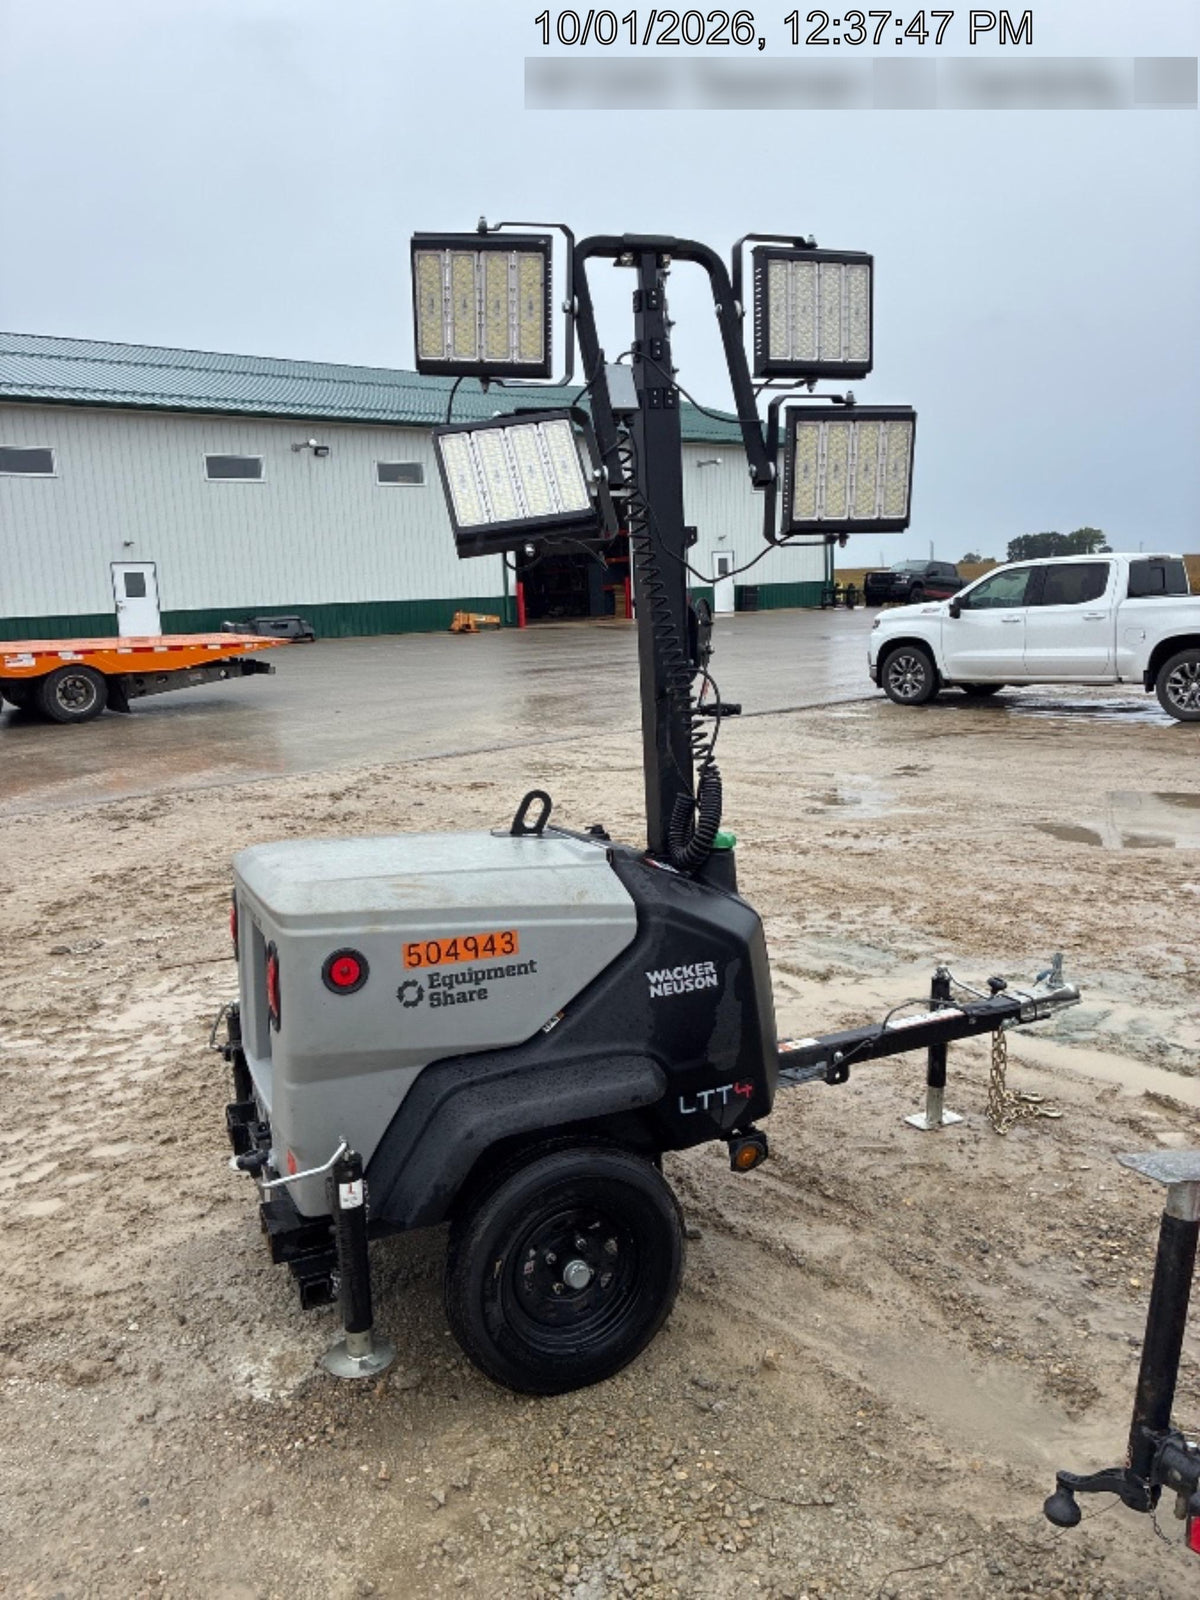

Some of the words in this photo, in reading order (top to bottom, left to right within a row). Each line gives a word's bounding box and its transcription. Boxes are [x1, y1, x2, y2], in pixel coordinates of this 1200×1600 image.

[406, 931, 515, 967] 504943
[427, 959, 538, 990] Equipment
[645, 961, 716, 984] WACKER
[649, 973, 718, 998] NEUSON
[429, 987, 489, 1009] Share
[679, 1082, 753, 1114] LTT4
